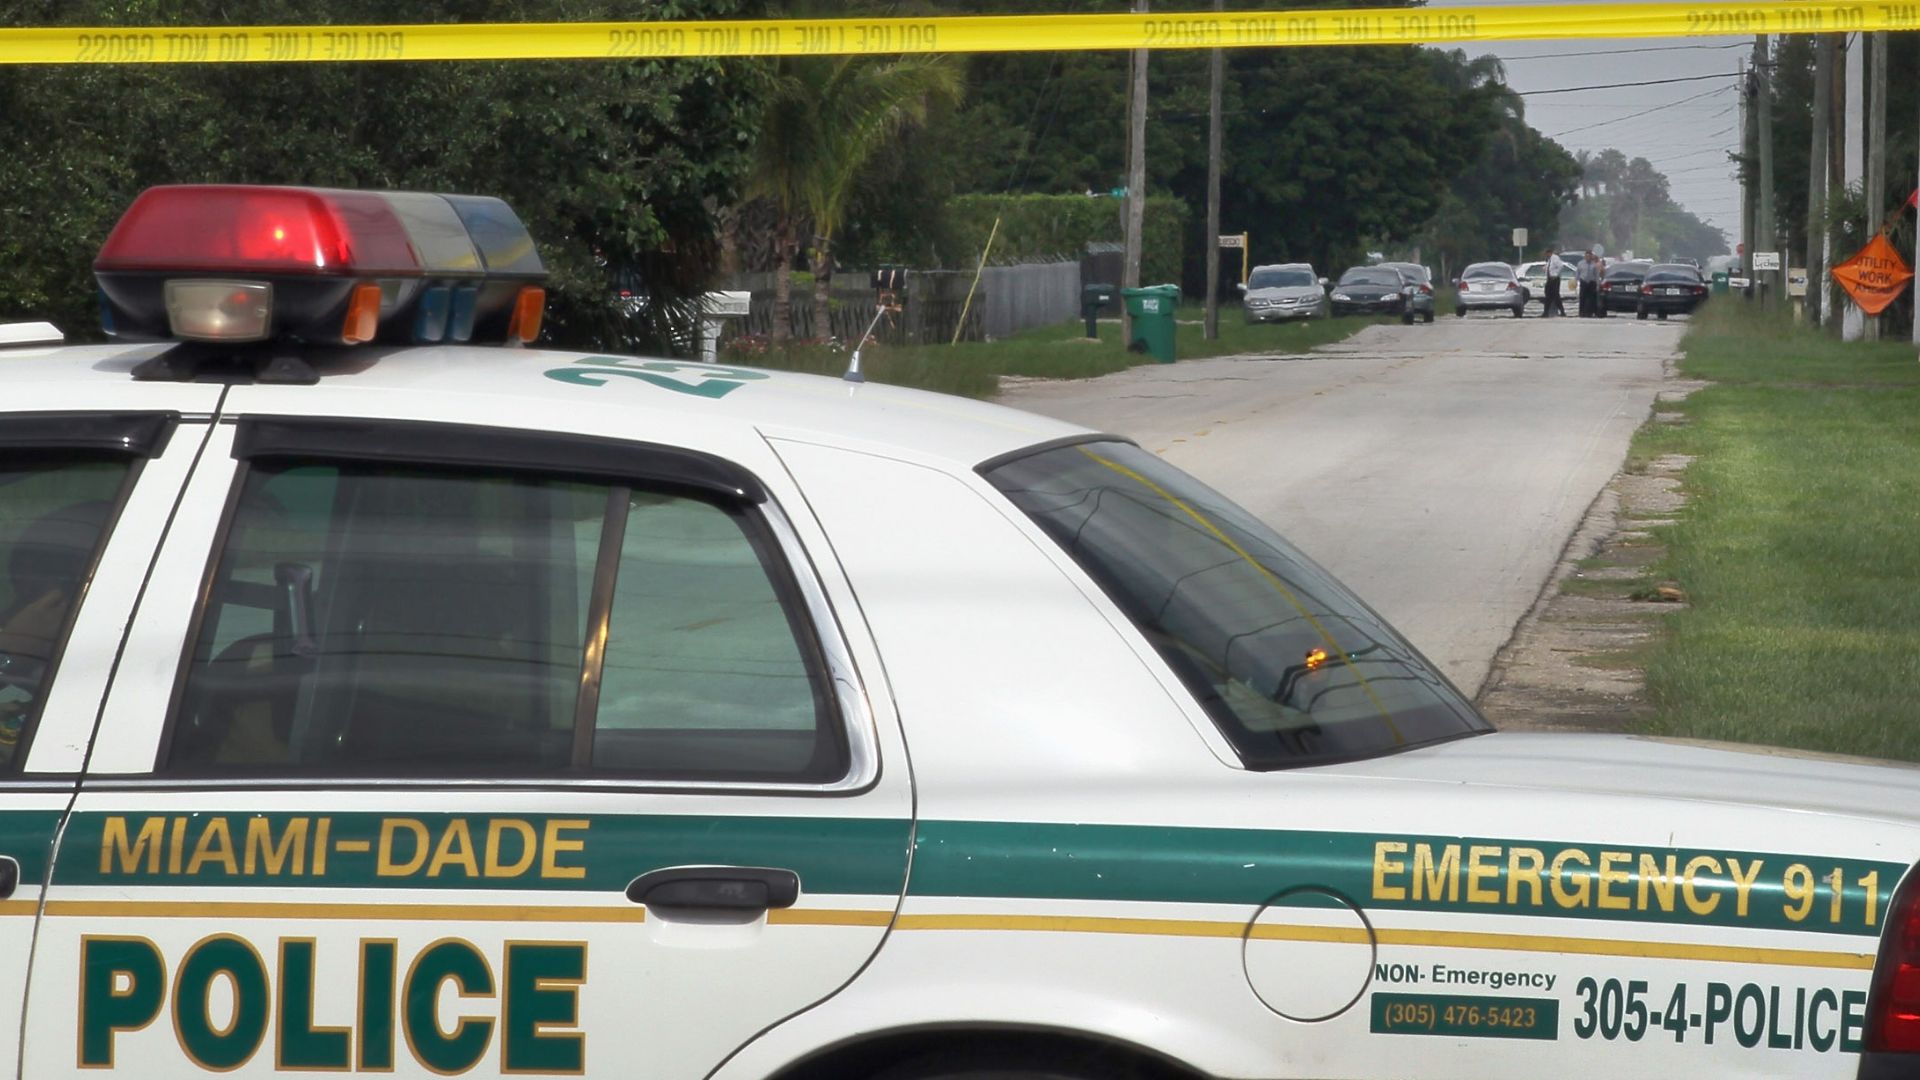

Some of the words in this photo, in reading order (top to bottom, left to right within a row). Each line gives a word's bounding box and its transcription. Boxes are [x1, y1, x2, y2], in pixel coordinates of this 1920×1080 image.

[1857, 256, 1897, 271] UTILITY
[1859, 271, 1892, 284] WORK
[100, 815, 591, 879] MIAMI-DADE
[1371, 841, 1764, 917] EMERGENCY
[1782, 863, 1879, 926] 911
[1375, 964, 1426, 984] NON-
[1432, 965, 1557, 991] Emergency
[76, 932, 589, 1077] POLICE
[1384, 1003, 1436, 1030] (305)
[1443, 1005, 1537, 1028] 476-5423
[1574, 976, 1868, 1053] 305-4-POLICE
